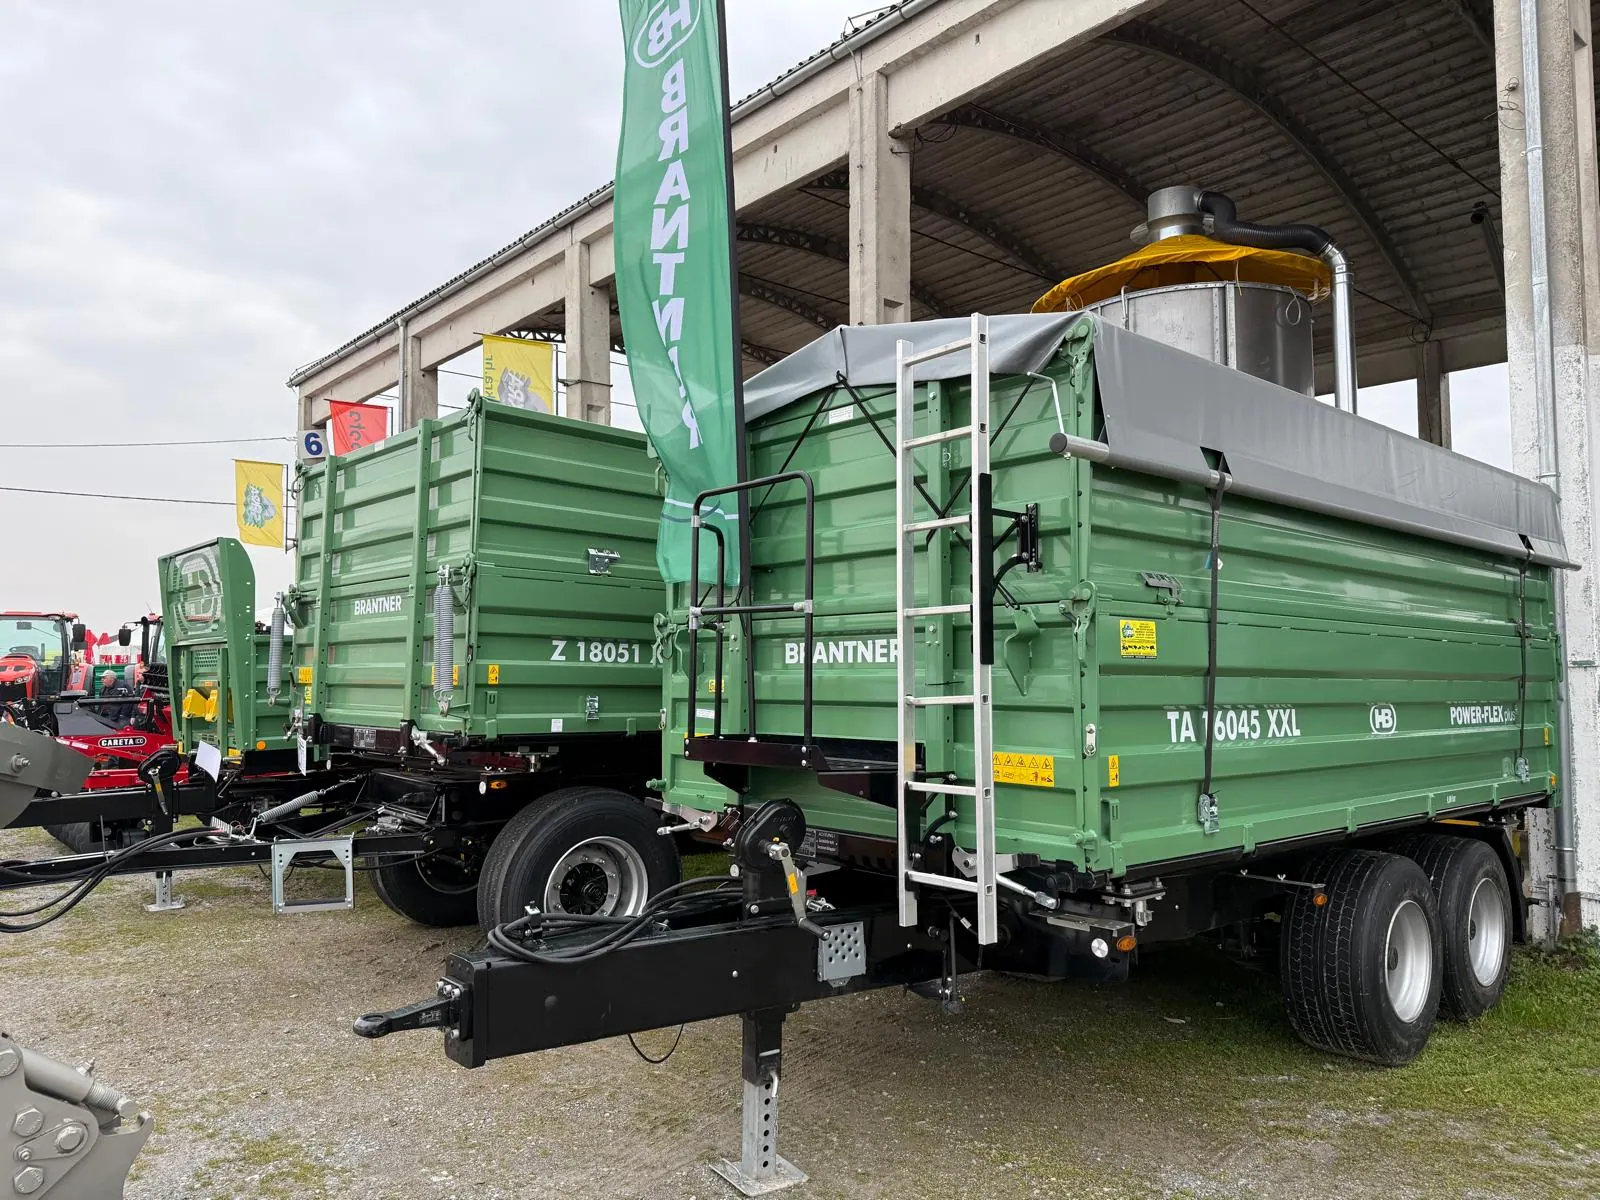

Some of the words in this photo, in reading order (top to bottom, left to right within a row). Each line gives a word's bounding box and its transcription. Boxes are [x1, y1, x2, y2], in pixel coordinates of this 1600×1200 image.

[304, 432, 323, 456] 6
[354, 595, 402, 615] BRANTNER
[550, 639, 567, 661] Z
[576, 641, 640, 663] 18051
[1166, 710, 1196, 743] TA
[1201, 709, 1260, 741] 16045
[1266, 708, 1301, 738] XXL
[1450, 705, 1504, 725] POWER-FLEX
[101, 738, 134, 747] CARETA
